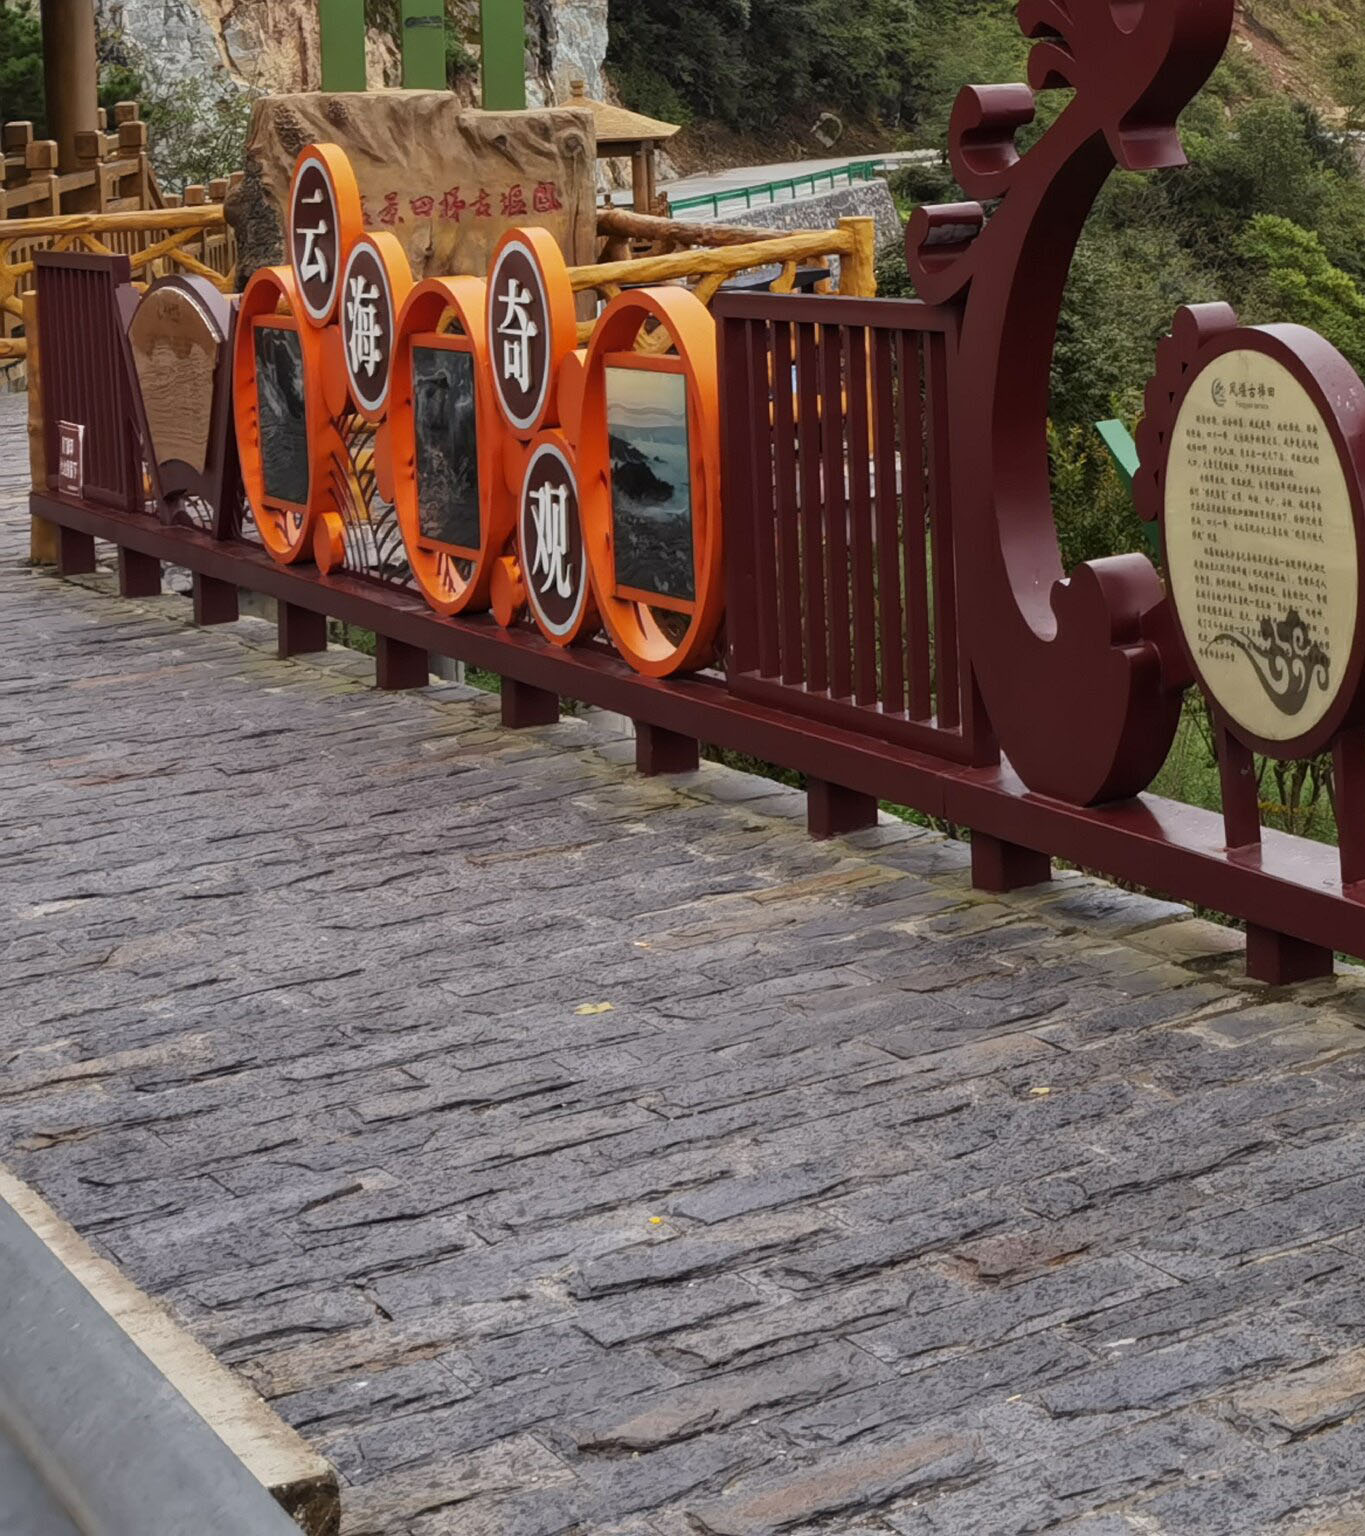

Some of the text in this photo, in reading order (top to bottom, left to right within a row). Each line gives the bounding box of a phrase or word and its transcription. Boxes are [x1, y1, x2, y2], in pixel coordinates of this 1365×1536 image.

[1229, 380, 1276, 399] 凤堰古梯田
